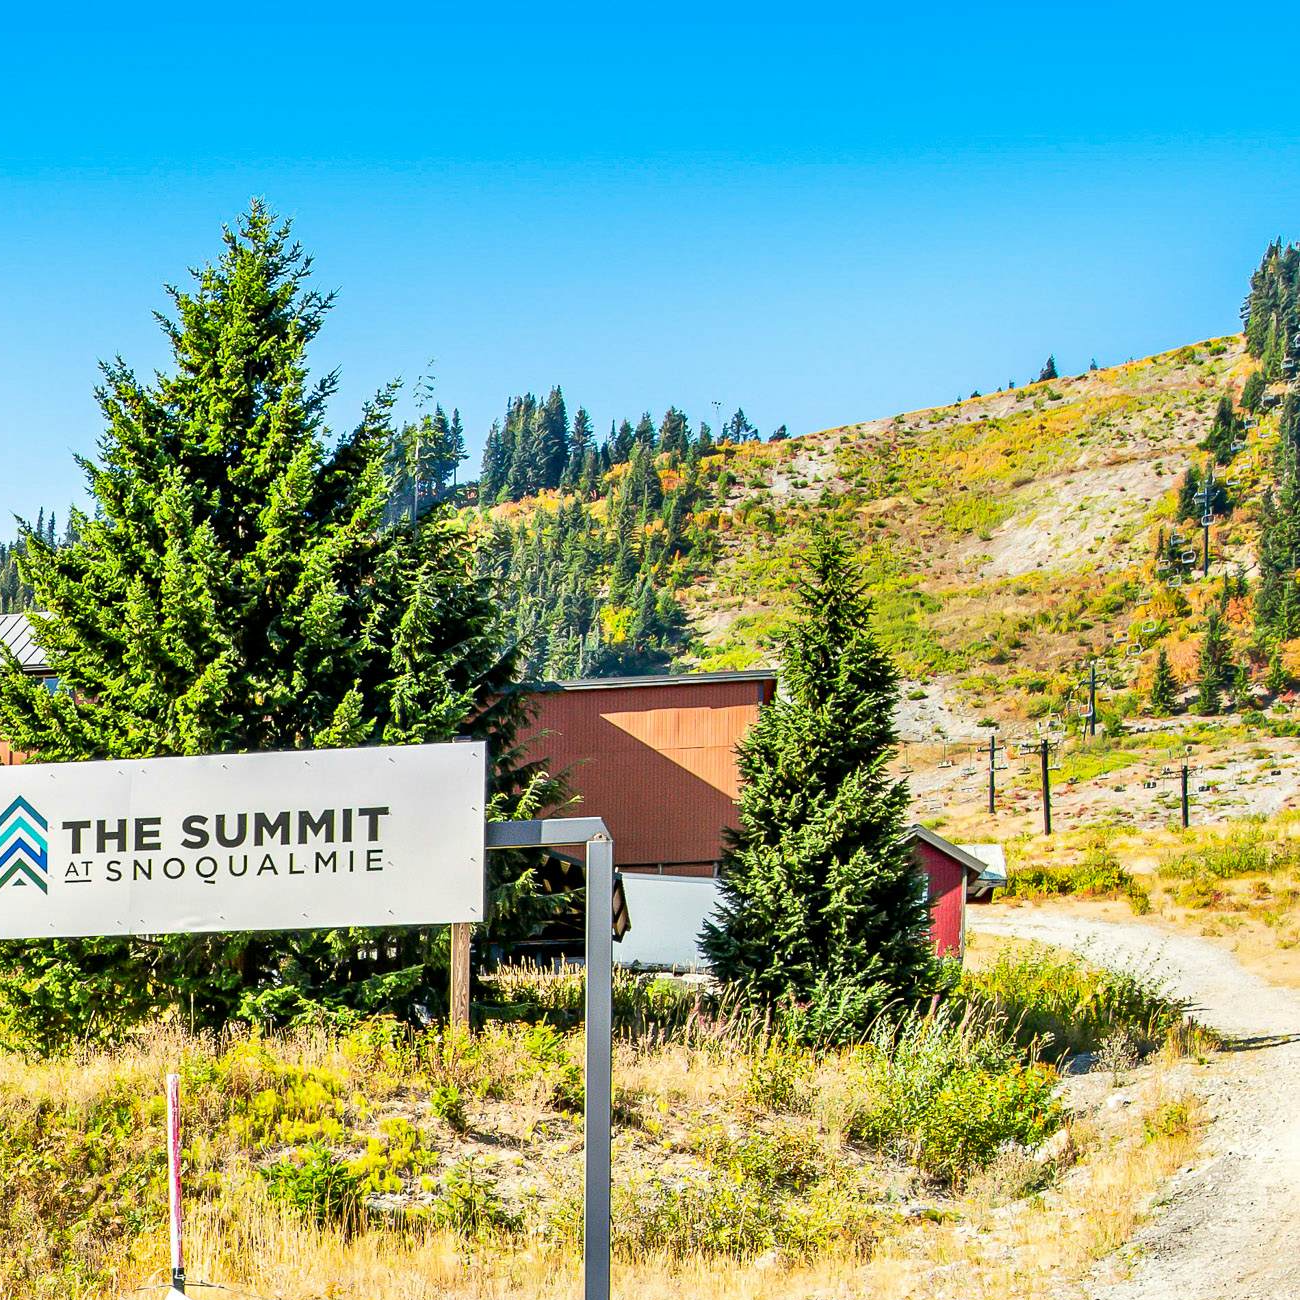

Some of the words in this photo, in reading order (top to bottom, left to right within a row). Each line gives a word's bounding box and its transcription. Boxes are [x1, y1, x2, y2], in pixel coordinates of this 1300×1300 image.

[61, 816, 162, 855] THE
[180, 806, 390, 850] SUMMIT
[64, 861, 94, 878] AT
[105, 849, 384, 885] SNOQUALMIE
